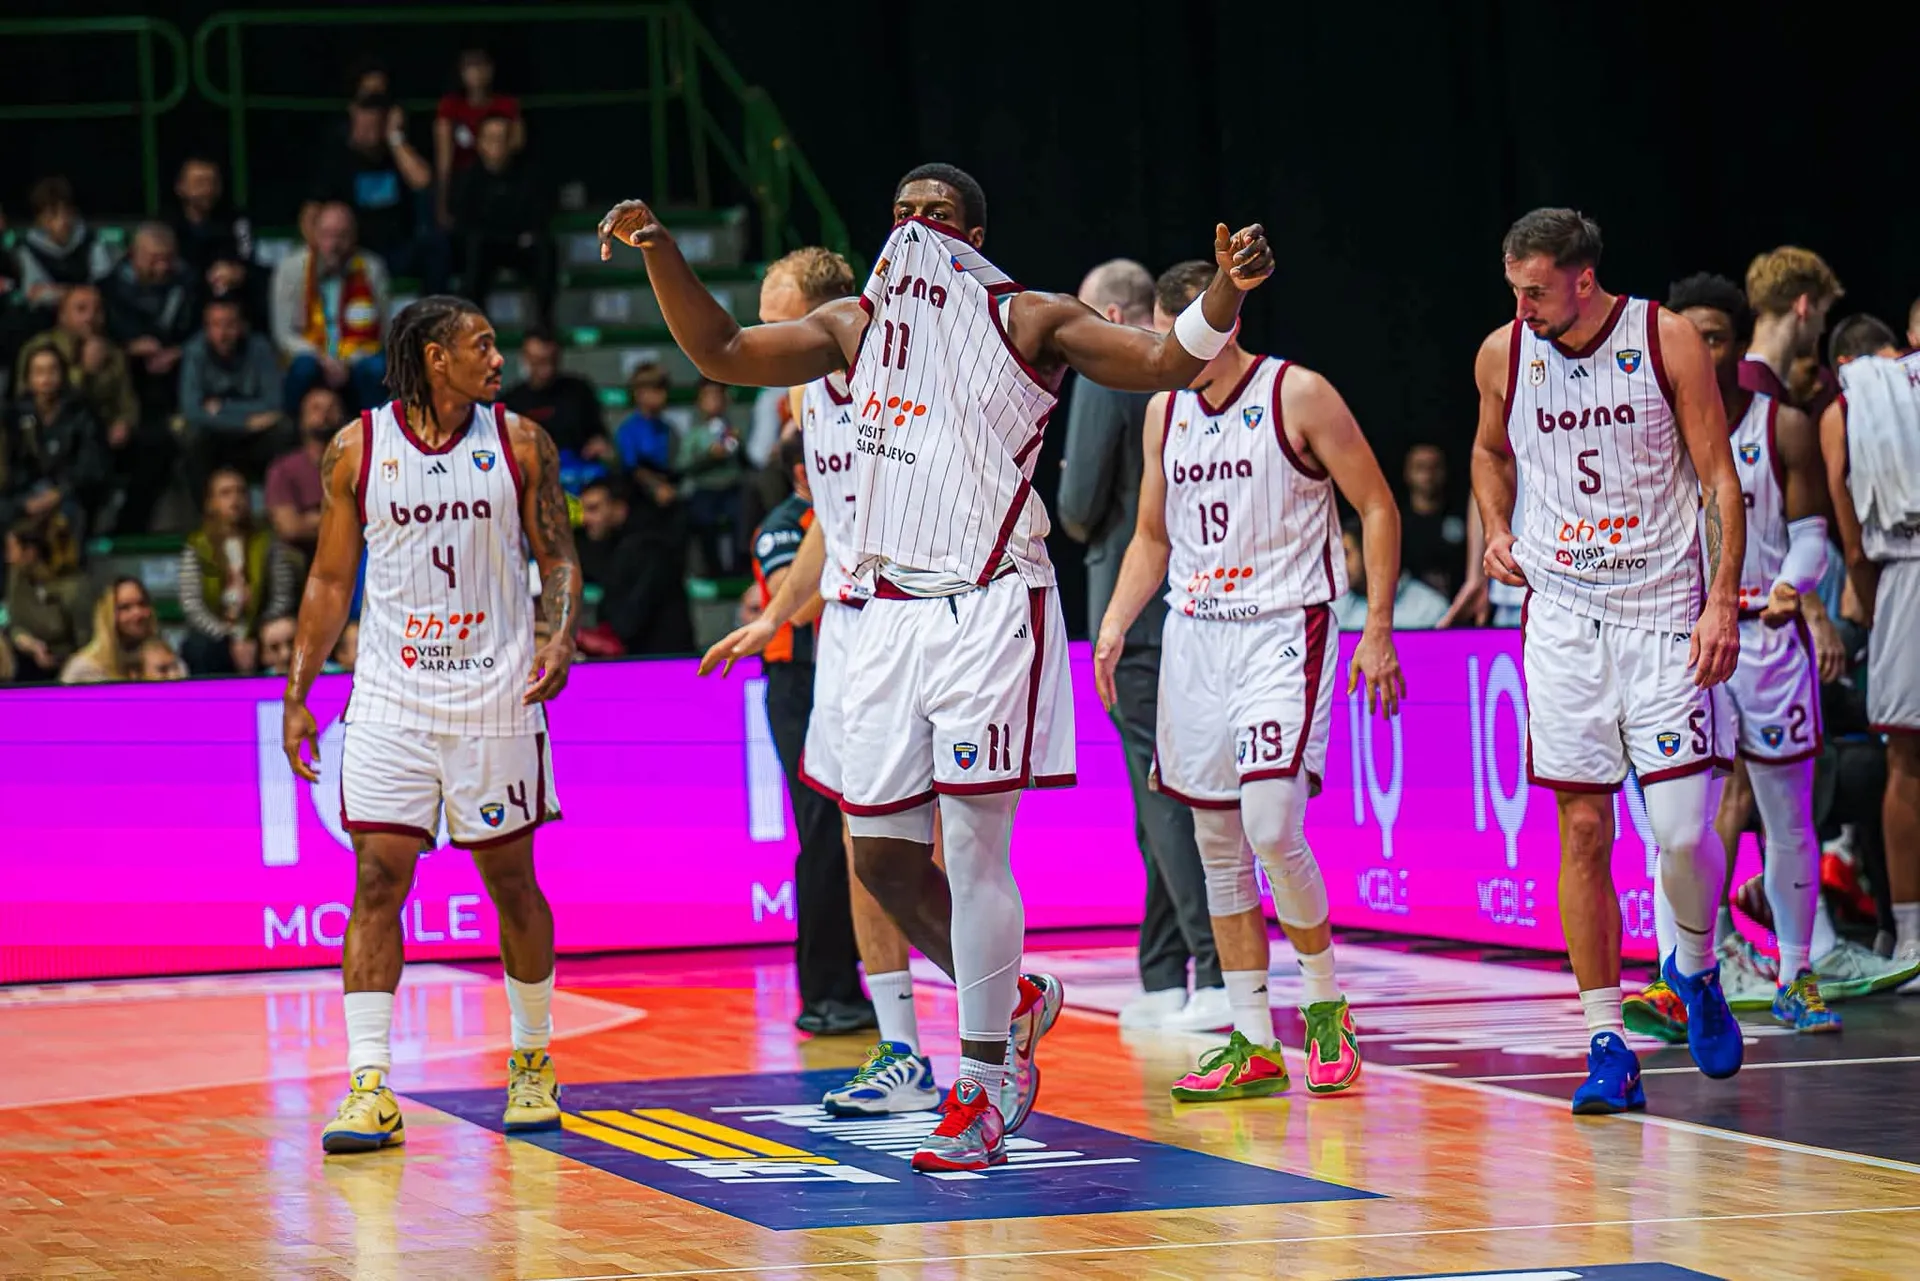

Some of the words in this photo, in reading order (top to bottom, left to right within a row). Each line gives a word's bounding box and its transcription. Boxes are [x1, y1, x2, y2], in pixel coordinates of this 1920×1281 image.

[884, 275, 947, 309] sna
[882, 319, 911, 370] 11
[858, 424, 886, 440] VISIT
[1537, 403, 1636, 434] bosna
[815, 450, 852, 475] bos
[857, 438, 916, 465] SARAJEVO
[1173, 459, 1253, 484] bosna
[1578, 449, 1601, 495] 5
[389, 499, 492, 526] bosna
[1199, 502, 1229, 545] 19
[432, 545, 457, 589] 4
[1571, 546, 1605, 560] VISIT
[404, 612, 444, 640] bh
[418, 645, 453, 657] VISIT
[419, 656, 495, 672] SARAJEVO
[1688, 709, 1708, 755] 5
[1787, 704, 1809, 744] 2
[987, 723, 1012, 771] 11
[1248, 720, 1283, 763] 19
[507, 780, 531, 821] 4
[263, 894, 482, 949] MOILE
